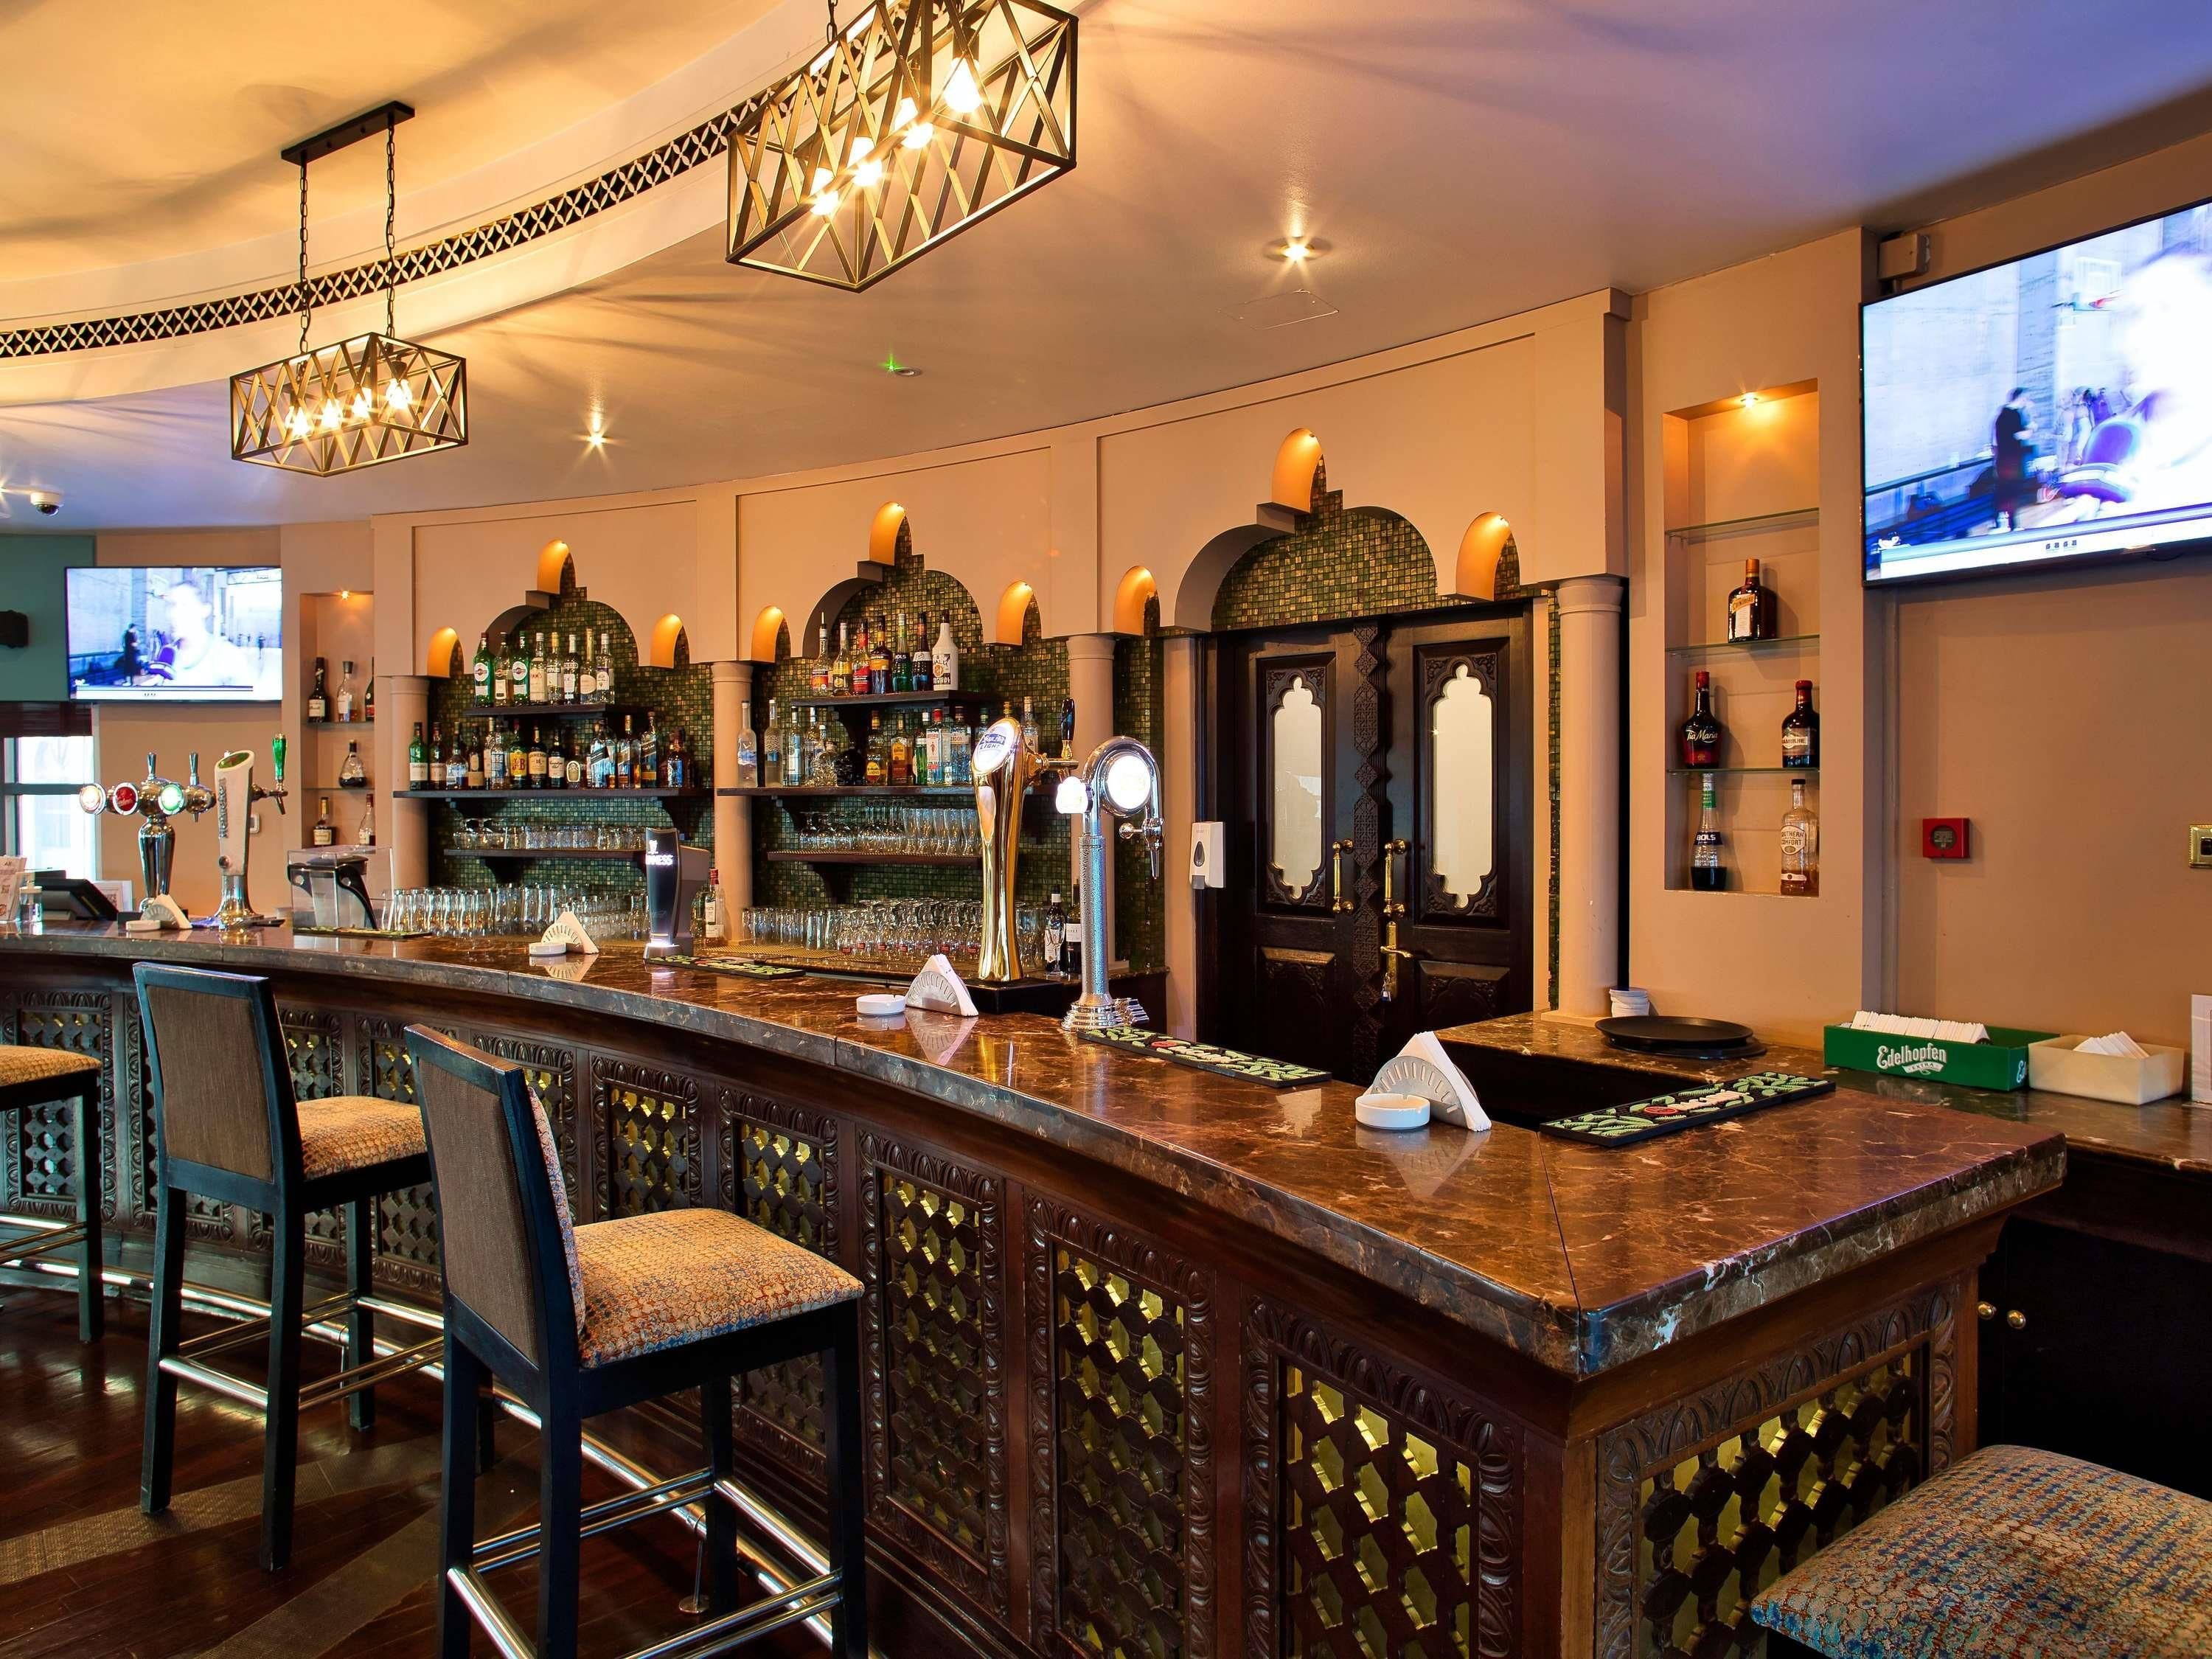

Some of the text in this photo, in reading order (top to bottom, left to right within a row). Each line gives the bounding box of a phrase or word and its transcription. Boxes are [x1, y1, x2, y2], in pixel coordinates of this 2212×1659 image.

[1686, 729, 1718, 742] Tia Maria
[1877, 1043, 1947, 1070] Edelhopfen
